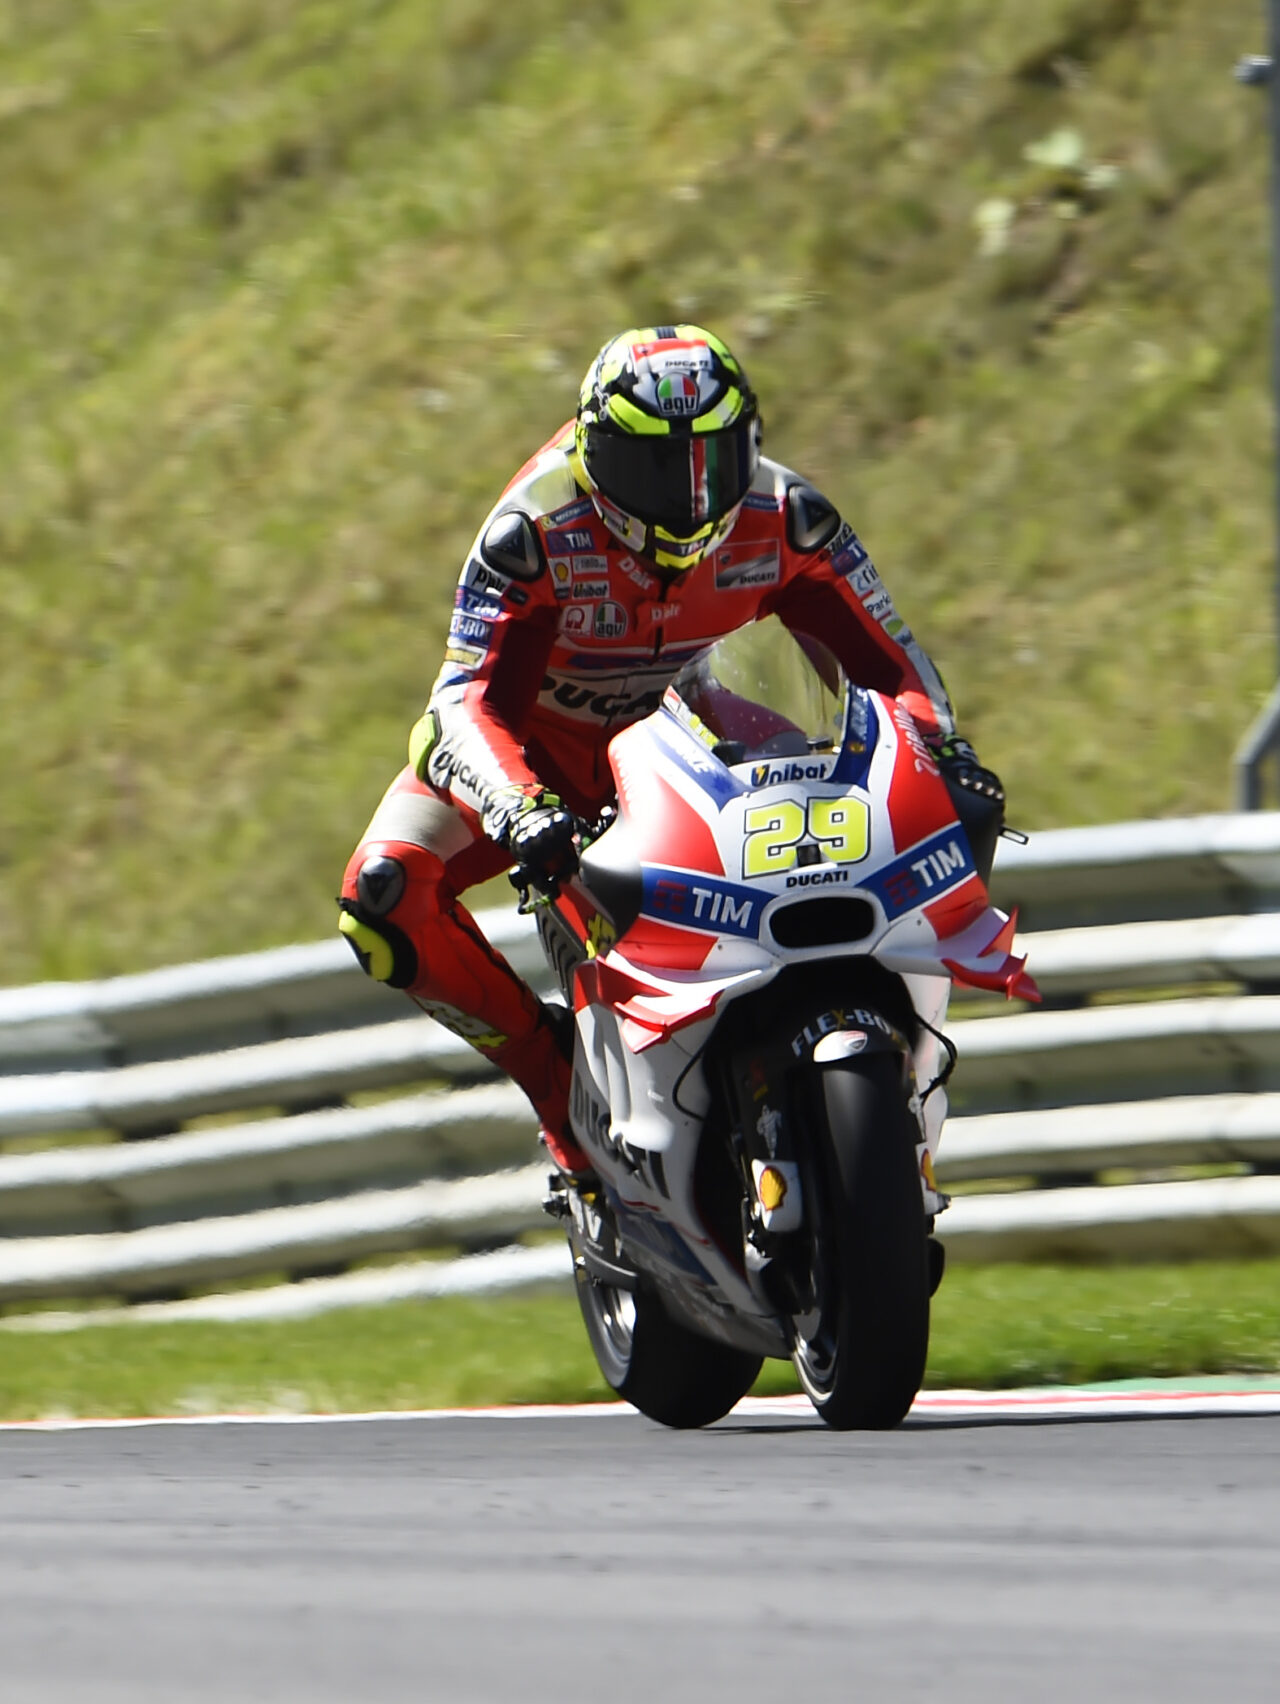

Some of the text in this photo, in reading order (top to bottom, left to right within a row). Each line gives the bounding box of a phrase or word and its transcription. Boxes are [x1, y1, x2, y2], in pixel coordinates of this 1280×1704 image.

[663, 395, 696, 412] agv
[565, 532, 593, 549] TIM
[739, 571, 776, 585] DUCATI
[596, 622, 623, 637] agv
[751, 763, 828, 787] Unibat
[742, 796, 871, 880] 29
[911, 841, 966, 888] TIM
[786, 870, 849, 888] DUCATI
[692, 887, 755, 930] TIM
